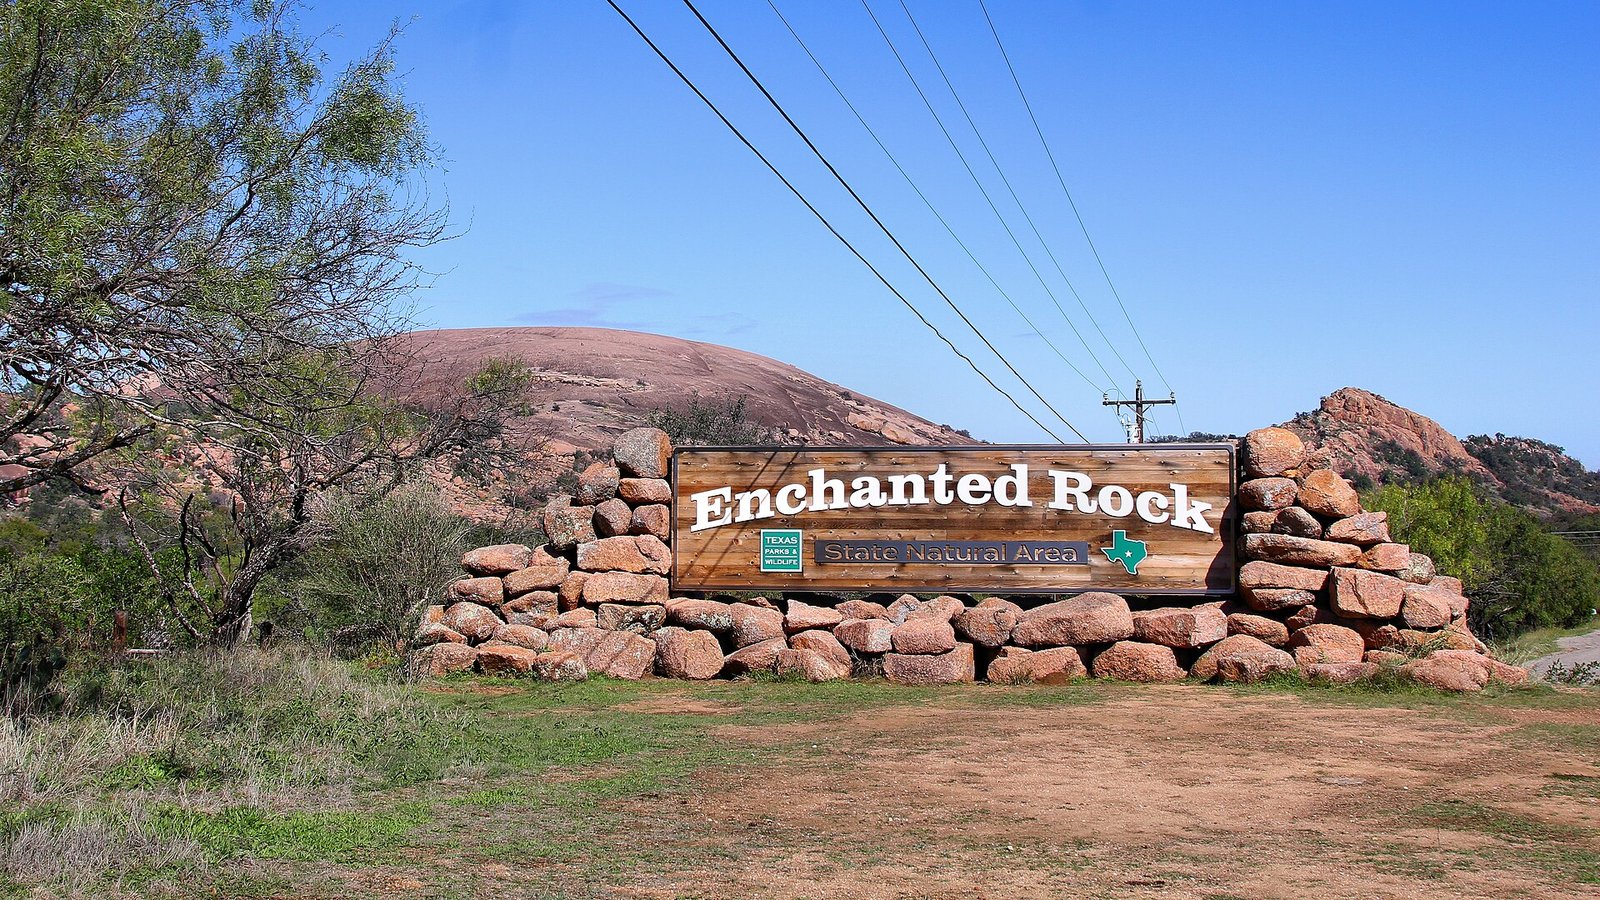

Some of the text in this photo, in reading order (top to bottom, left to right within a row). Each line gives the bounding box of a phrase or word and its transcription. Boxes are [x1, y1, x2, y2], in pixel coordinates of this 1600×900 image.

[691, 464, 1214, 534] Enchanted Rock
[765, 536, 798, 544] TEXAS
[824, 542, 1078, 562] State Natural Area
